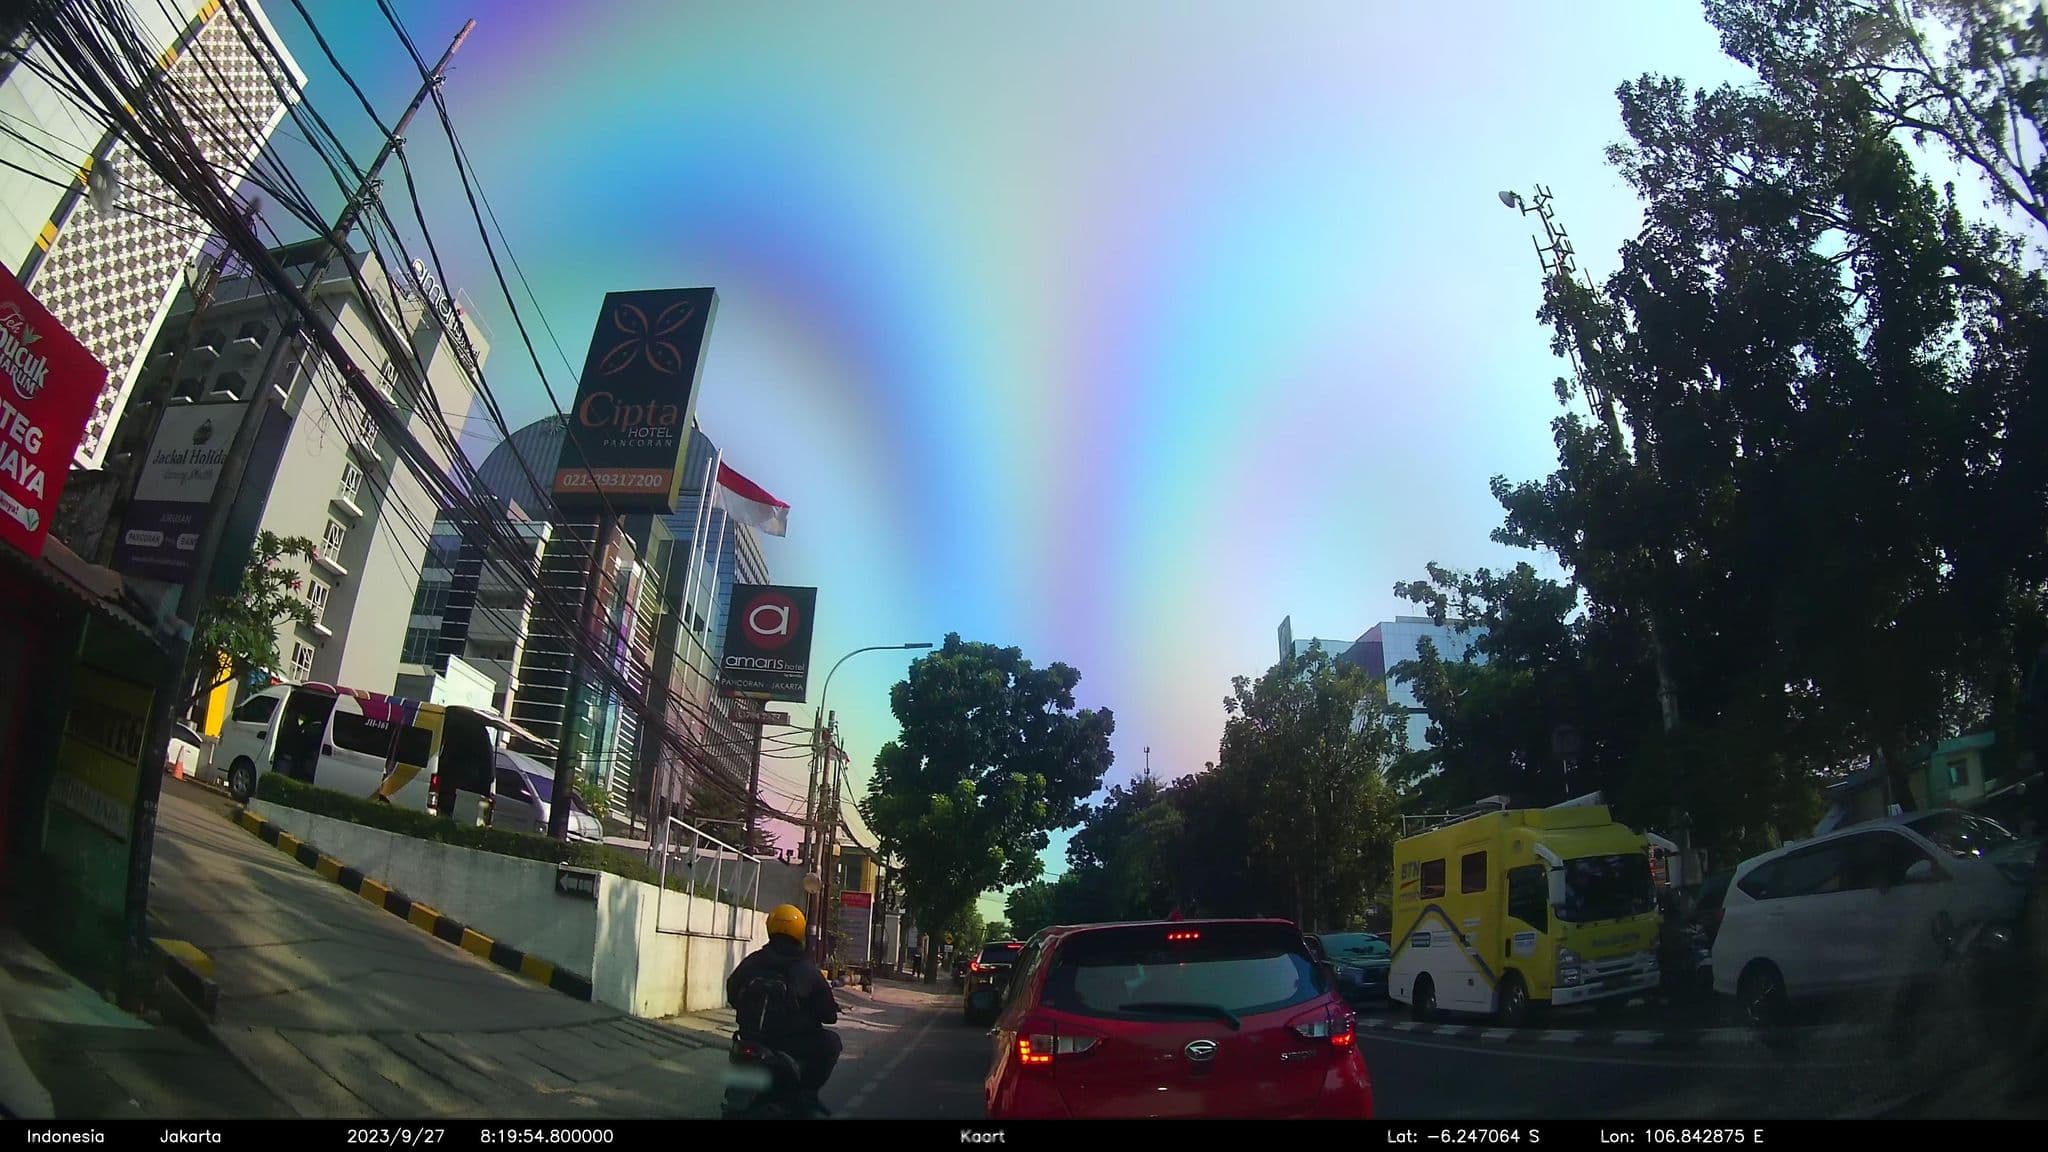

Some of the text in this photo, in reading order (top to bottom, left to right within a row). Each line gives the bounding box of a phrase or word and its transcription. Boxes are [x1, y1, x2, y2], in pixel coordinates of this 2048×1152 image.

[579, 391, 678, 432] Cipta
[0, 397, 44, 455] TEG
[628, 427, 673, 438] HOTEL
[602, 439, 673, 448] PANCORAN
[152, 449, 189, 465] Jackal
[725, 655, 805, 672] amaris hotel
[721, 679, 804, 690] PANCORAN JAKARTA
